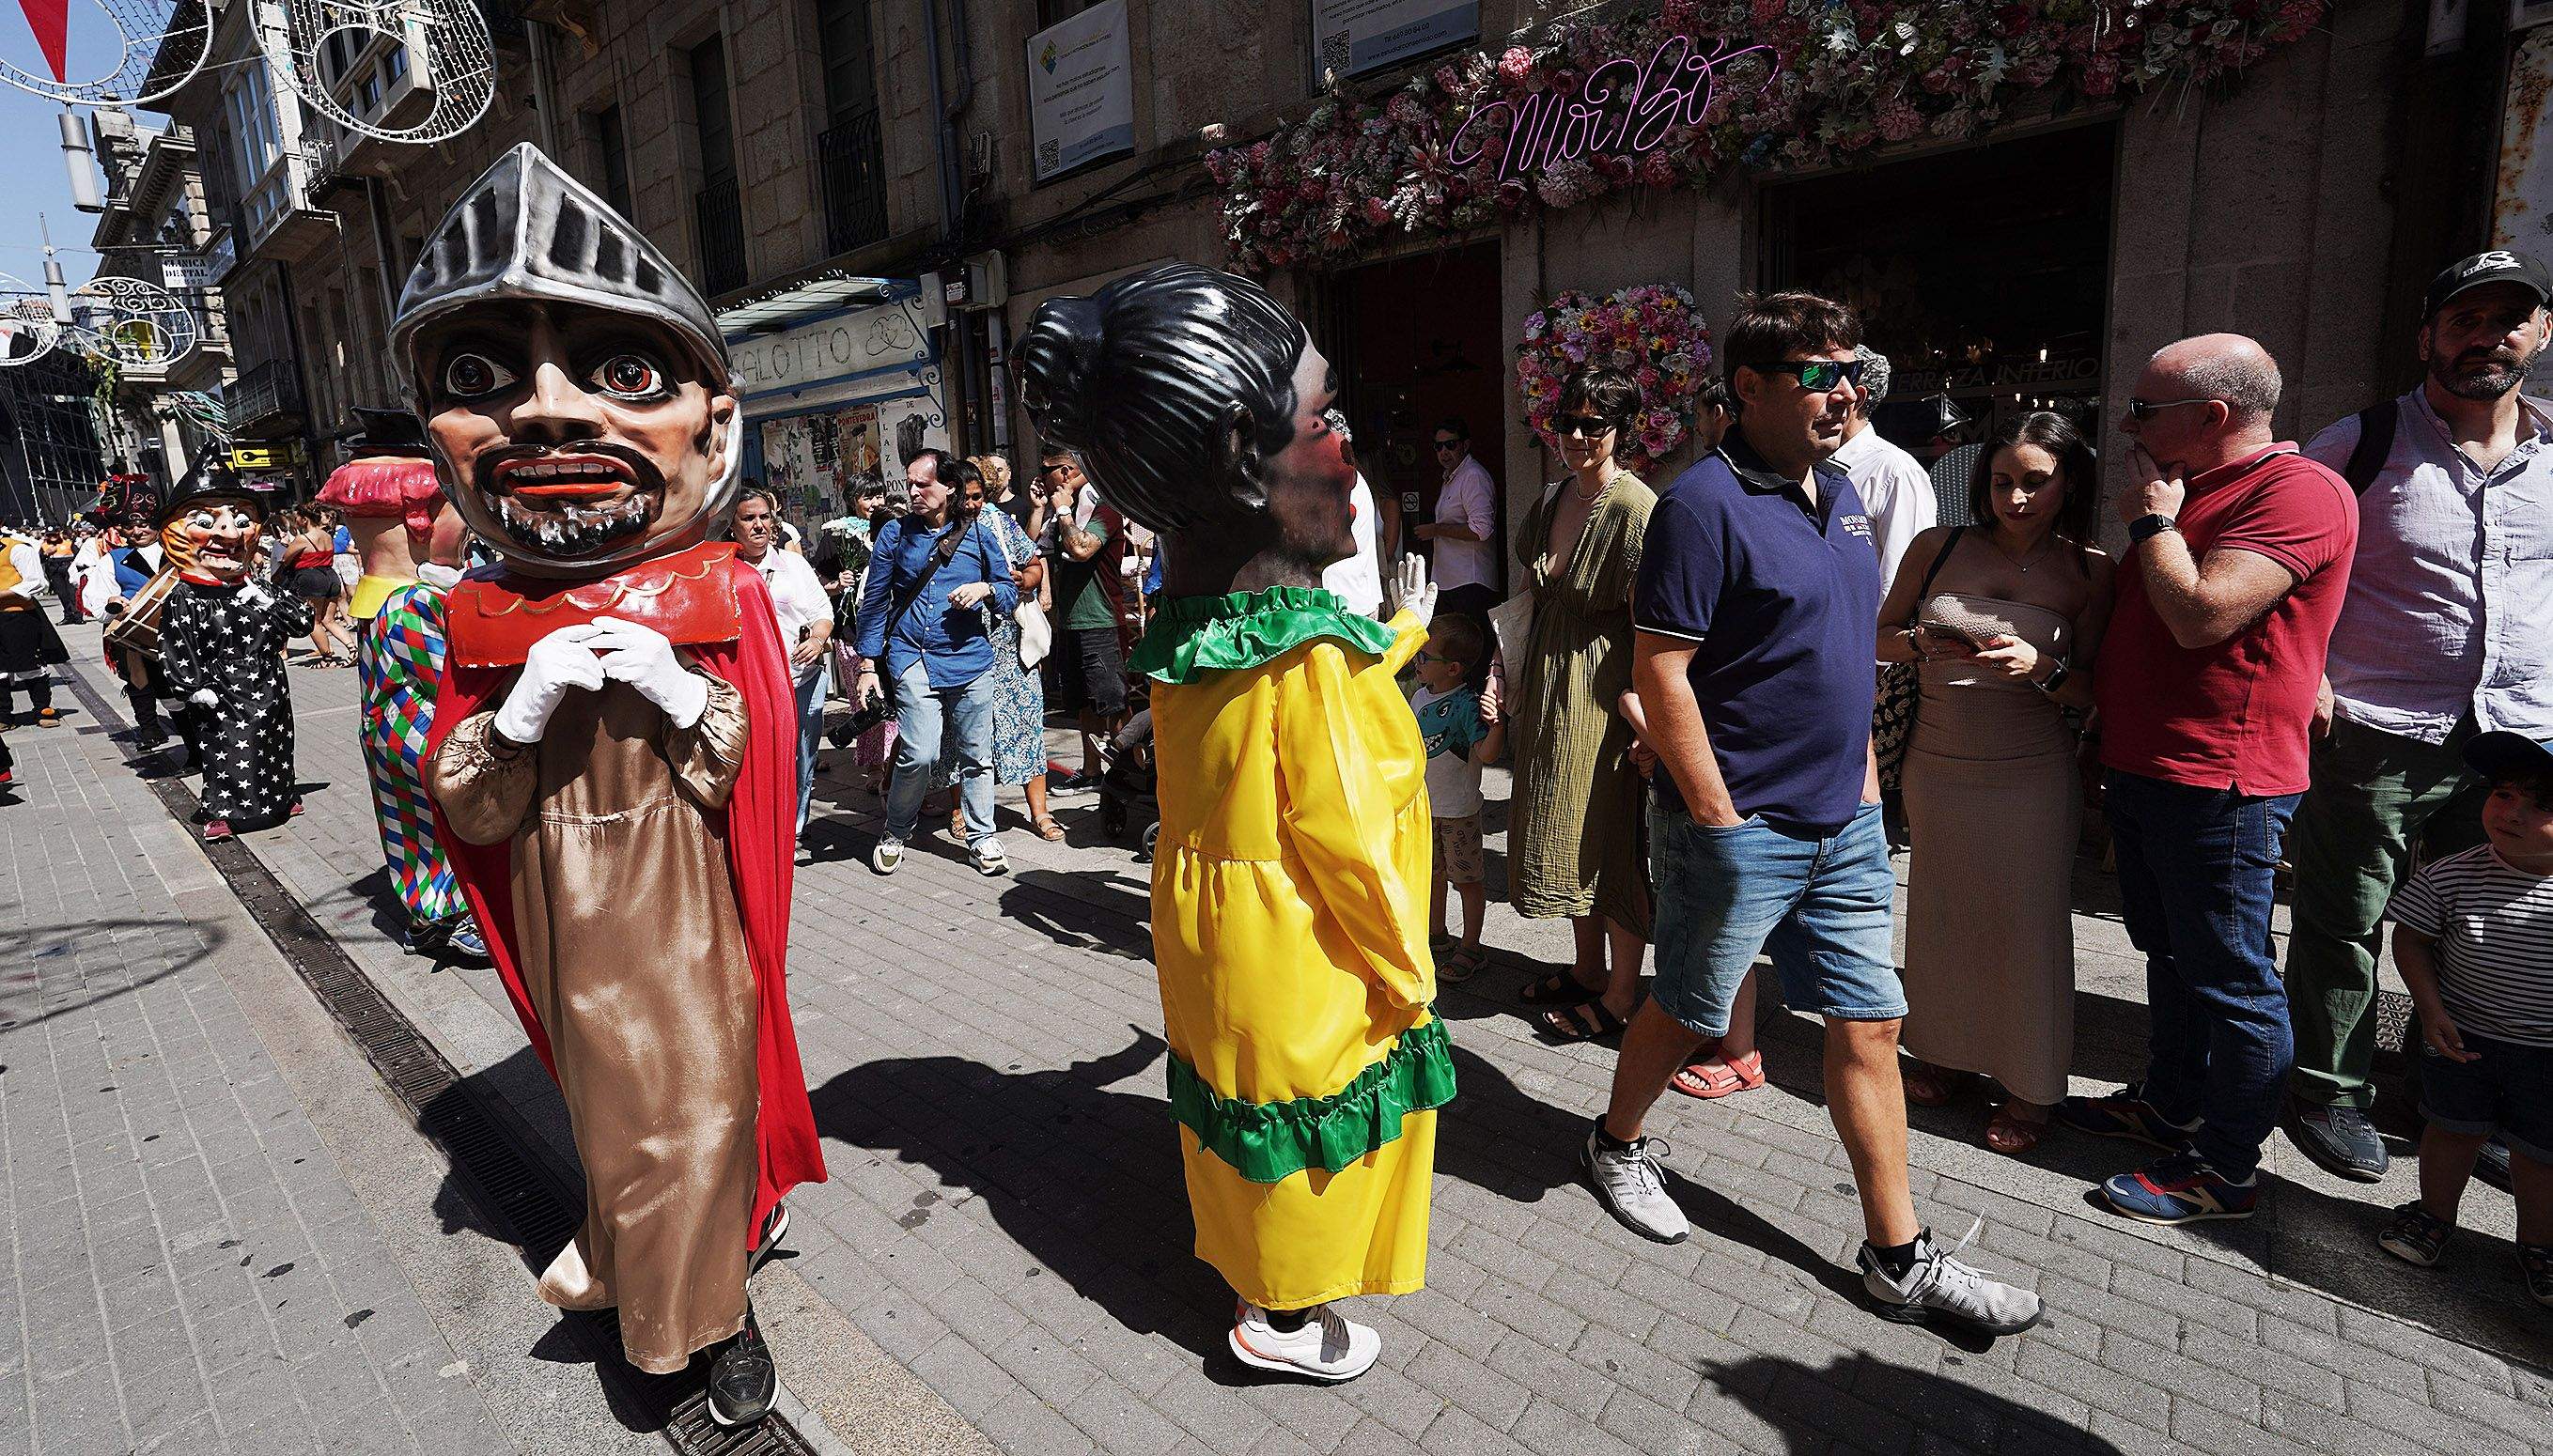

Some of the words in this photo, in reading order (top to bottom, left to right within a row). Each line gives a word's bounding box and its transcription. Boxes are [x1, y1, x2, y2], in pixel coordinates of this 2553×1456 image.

[165, 270, 209, 278] DENTAL
[907, 400, 915, 409] DE
[837, 411, 877, 426] PONTEVEDRA
[881, 408, 894, 477] PLAZA
